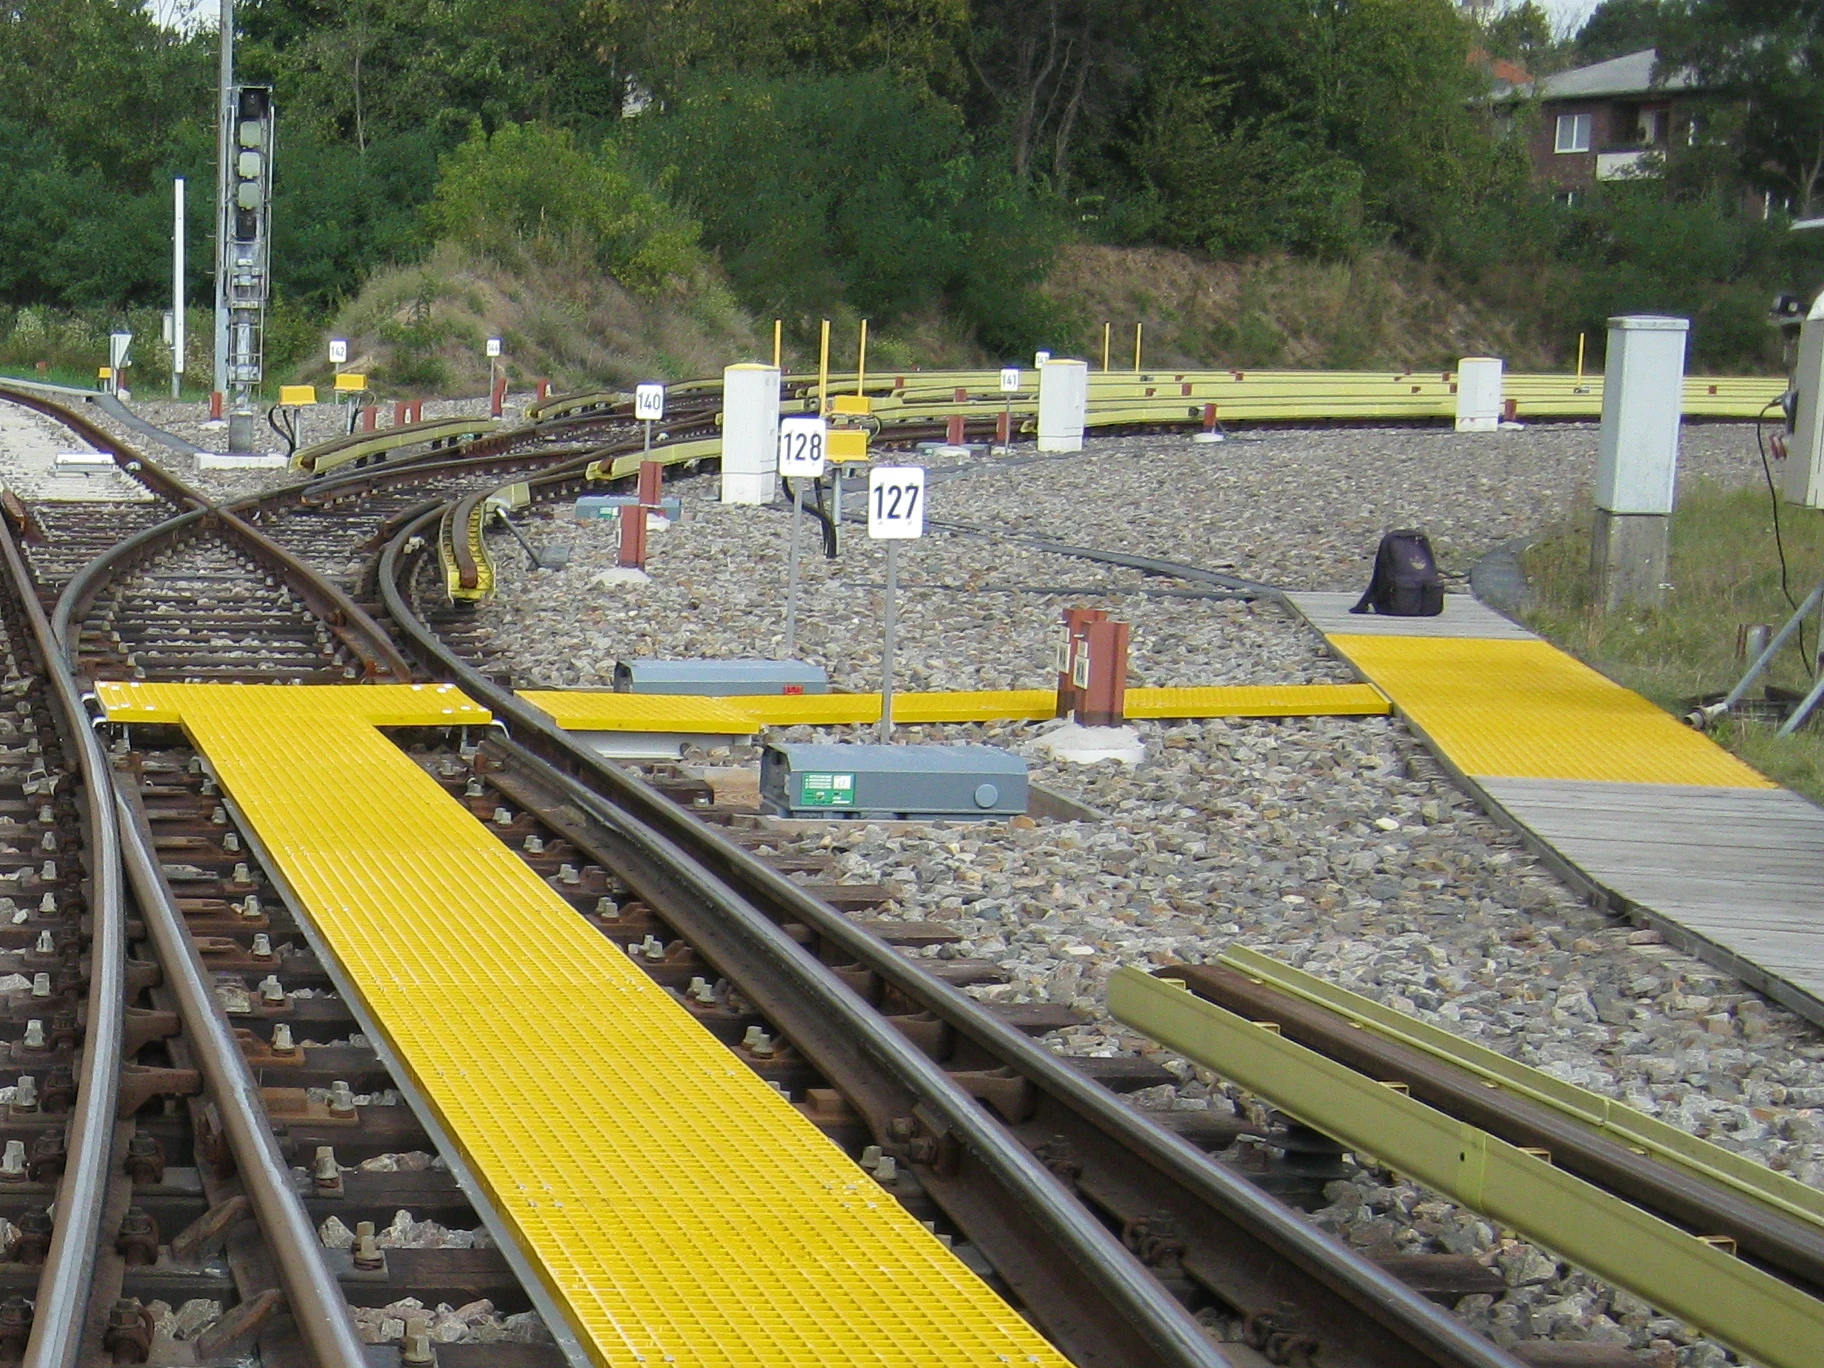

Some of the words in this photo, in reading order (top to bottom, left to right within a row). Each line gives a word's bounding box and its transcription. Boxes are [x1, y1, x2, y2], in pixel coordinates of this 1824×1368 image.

[638, 391, 661, 410] 140
[783, 432, 822, 461] 128
[873, 484, 920, 519] 127
